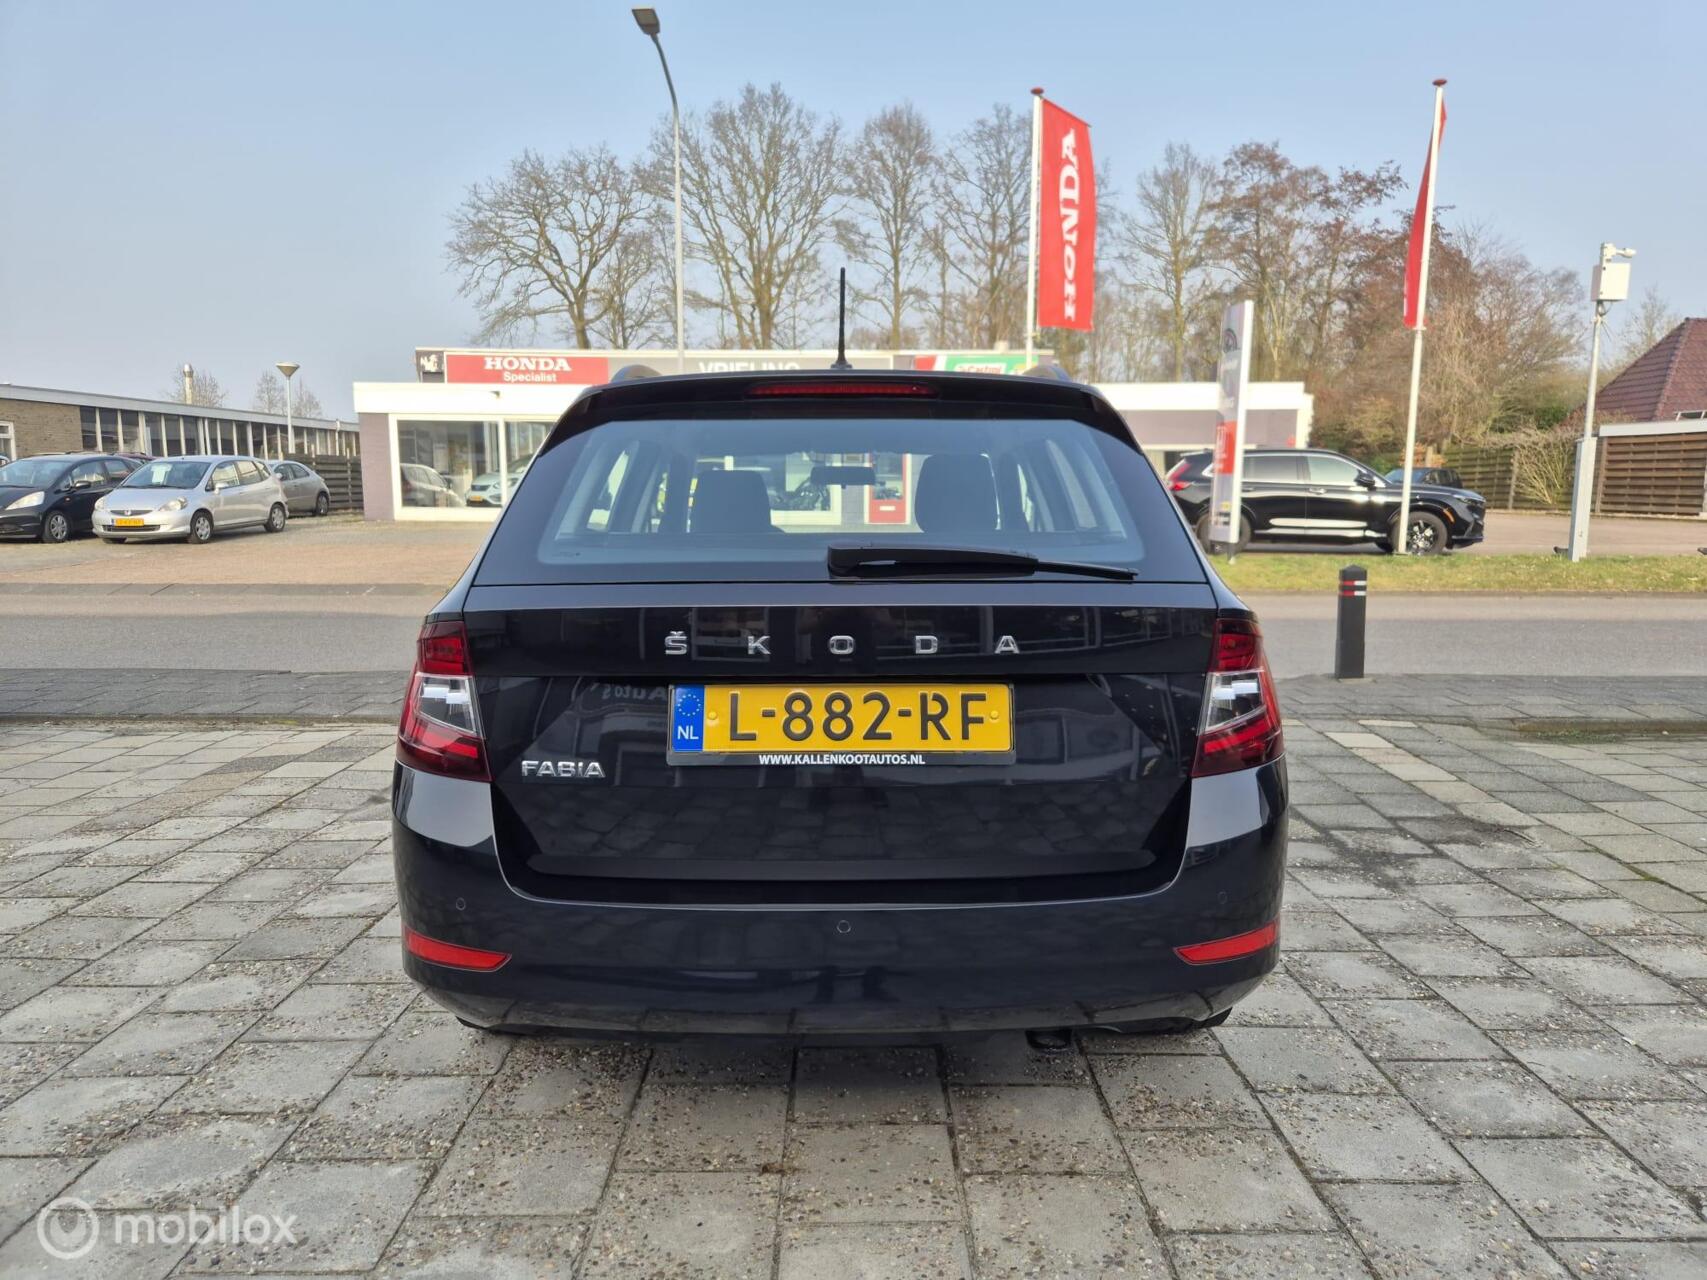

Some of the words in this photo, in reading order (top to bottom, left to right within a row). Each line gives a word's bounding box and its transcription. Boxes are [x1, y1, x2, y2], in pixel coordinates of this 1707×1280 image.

[1059, 128, 1079, 322] HONDA
[483, 357, 572, 371] HONDA
[503, 372, 557, 383] Specialist
[664, 631, 1020, 656] ŠKODA
[729, 691, 988, 742] L-882-RF
[676, 725, 699, 741] NL
[758, 753, 926, 765] WWW.KALLENKOOTAUTOS.NL
[521, 760, 606, 778] FABIA
